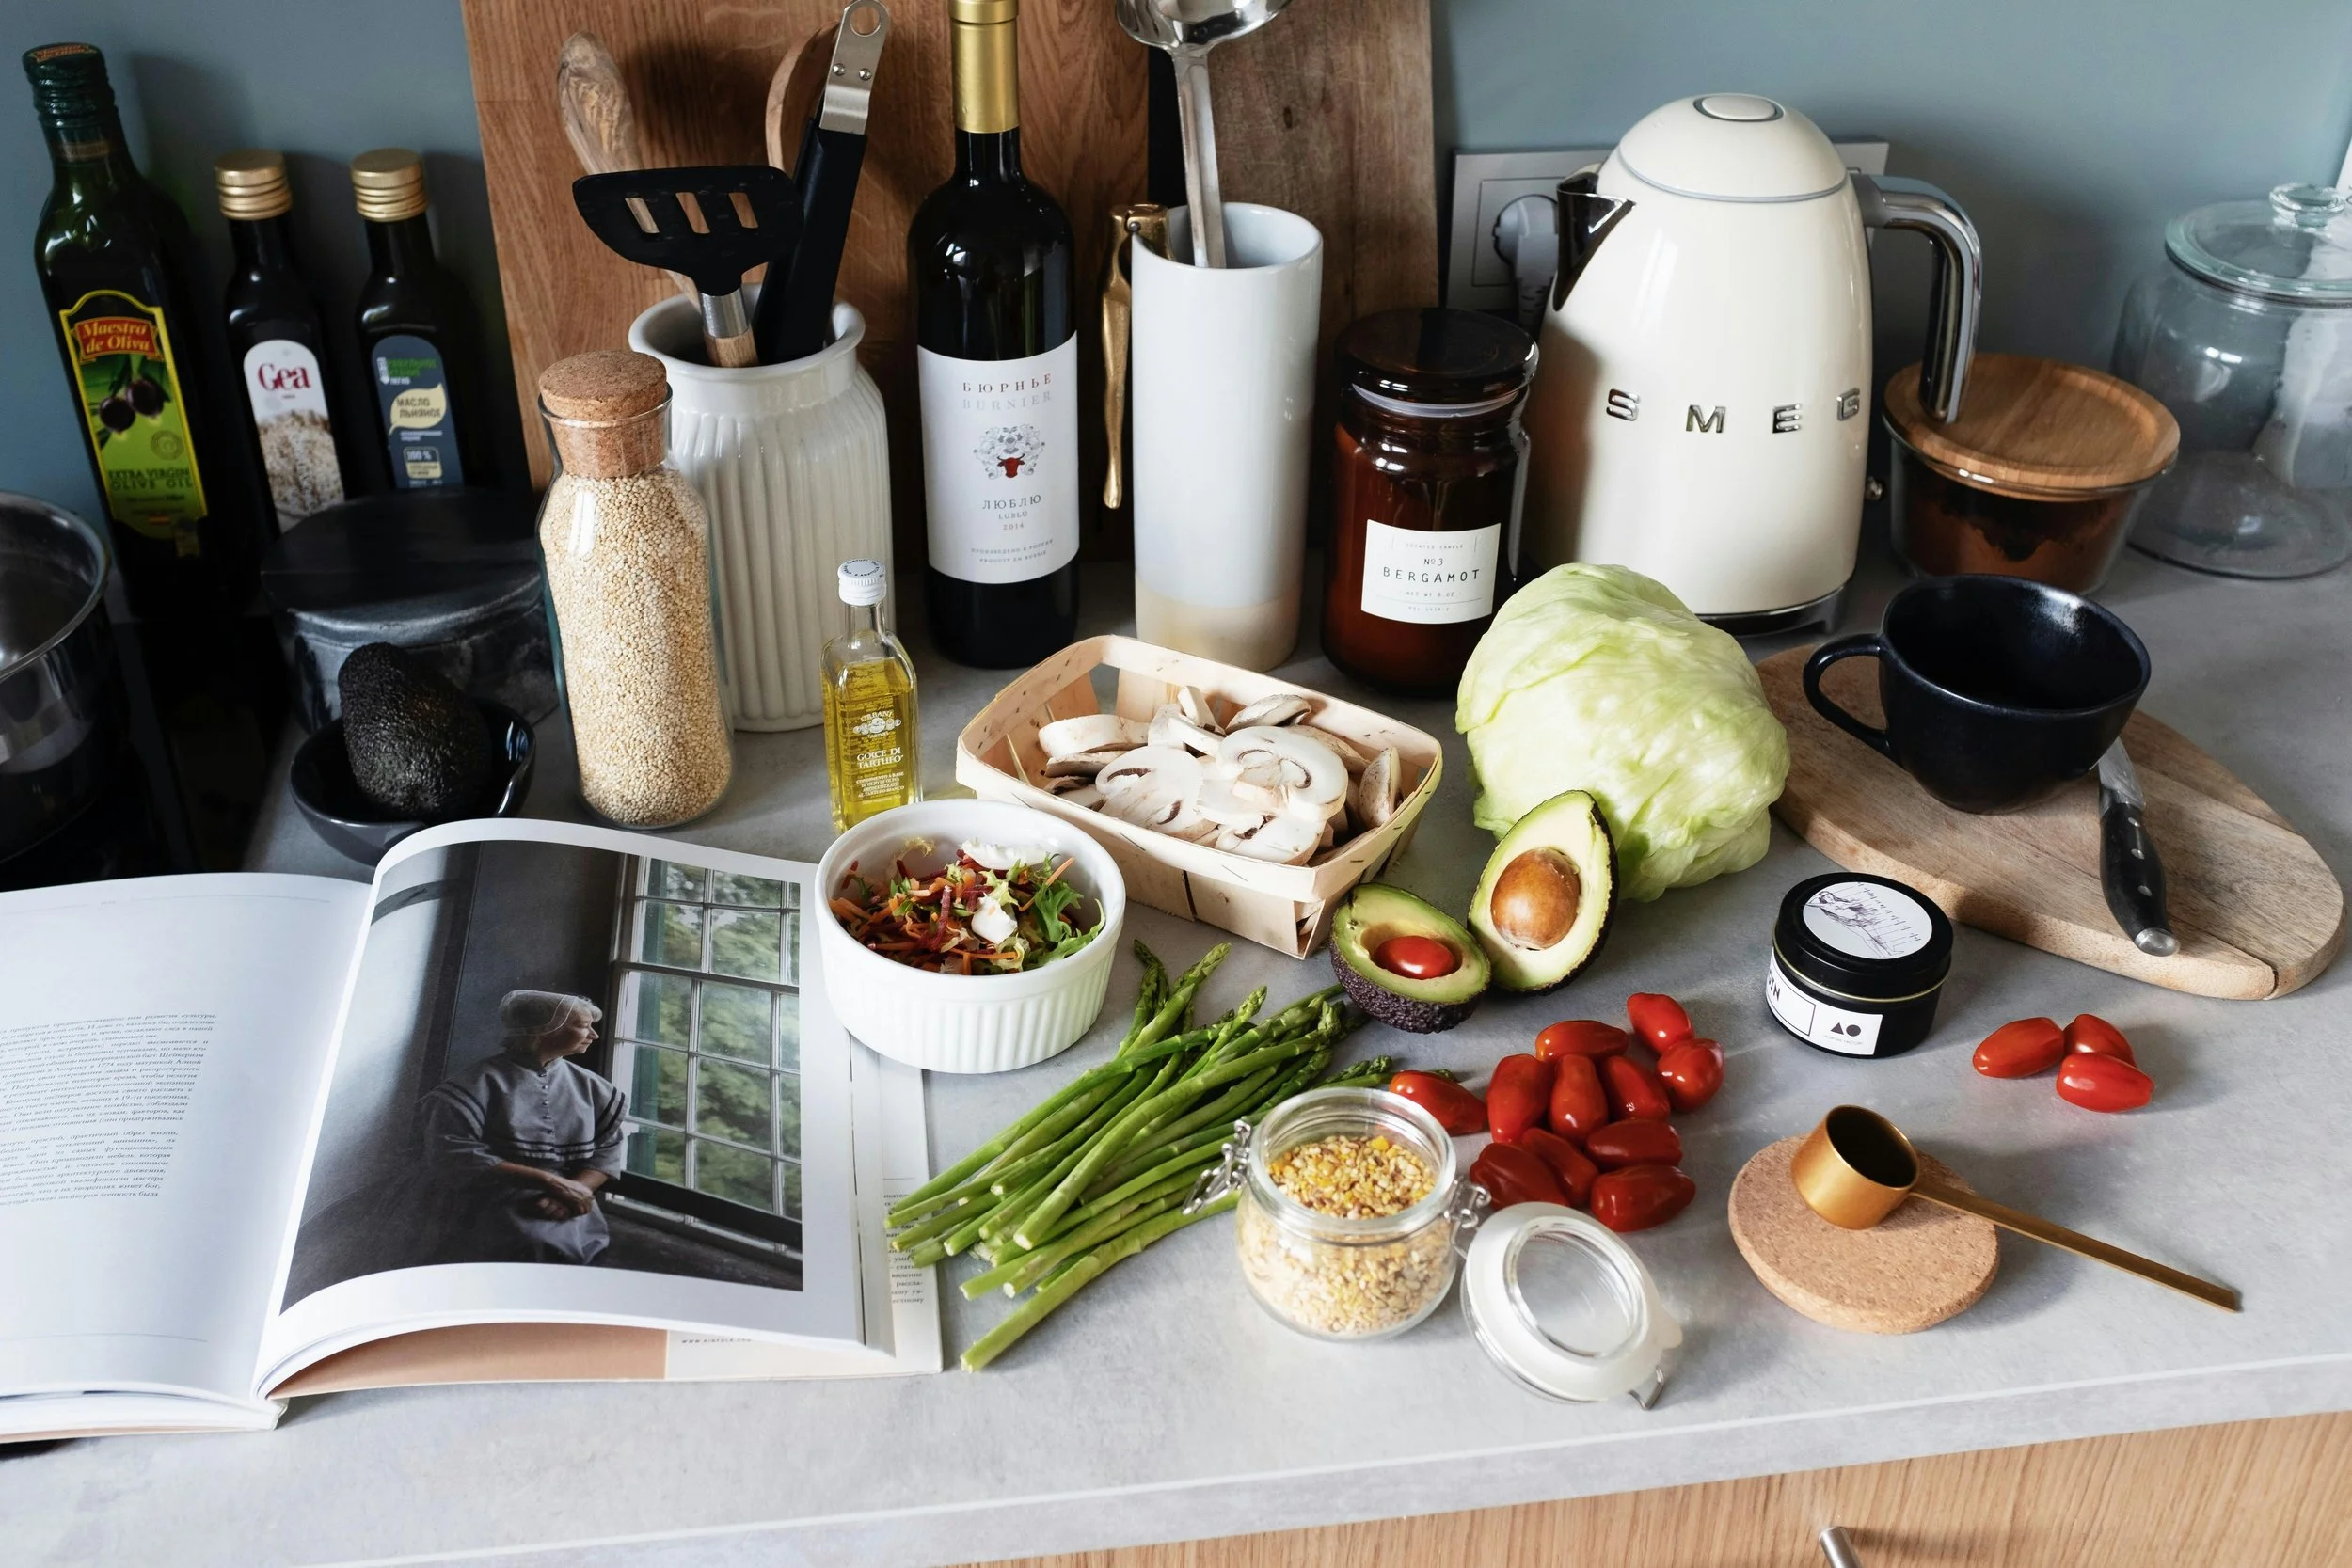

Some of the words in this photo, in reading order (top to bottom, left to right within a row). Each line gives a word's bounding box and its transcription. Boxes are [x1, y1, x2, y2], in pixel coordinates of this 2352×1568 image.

[84, 322, 148, 336] Maestro
[87, 339, 103, 354] de
[107, 335, 150, 350] Oliva
[258, 363, 311, 391] Gea
[961, 373, 1052, 393] БЮРНЬЕ
[397, 398, 430, 406] МАСЛО
[961, 391, 1052, 411] BURNIER
[1606, 388, 1860, 433] SMEG
[108, 469, 143, 480] EXTRA
[145, 467, 190, 479] VIRGIN
[111, 478, 155, 491] OLIVE
[165, 477, 193, 489] OIL
[981, 494, 1041, 511] ЛЮБЛЮ
[998, 511, 1028, 520] LUBLU
[1438, 558, 1444, 567] 3
[1383, 566, 1480, 584] BERGAMOT
[890, 746, 902, 756] DI
